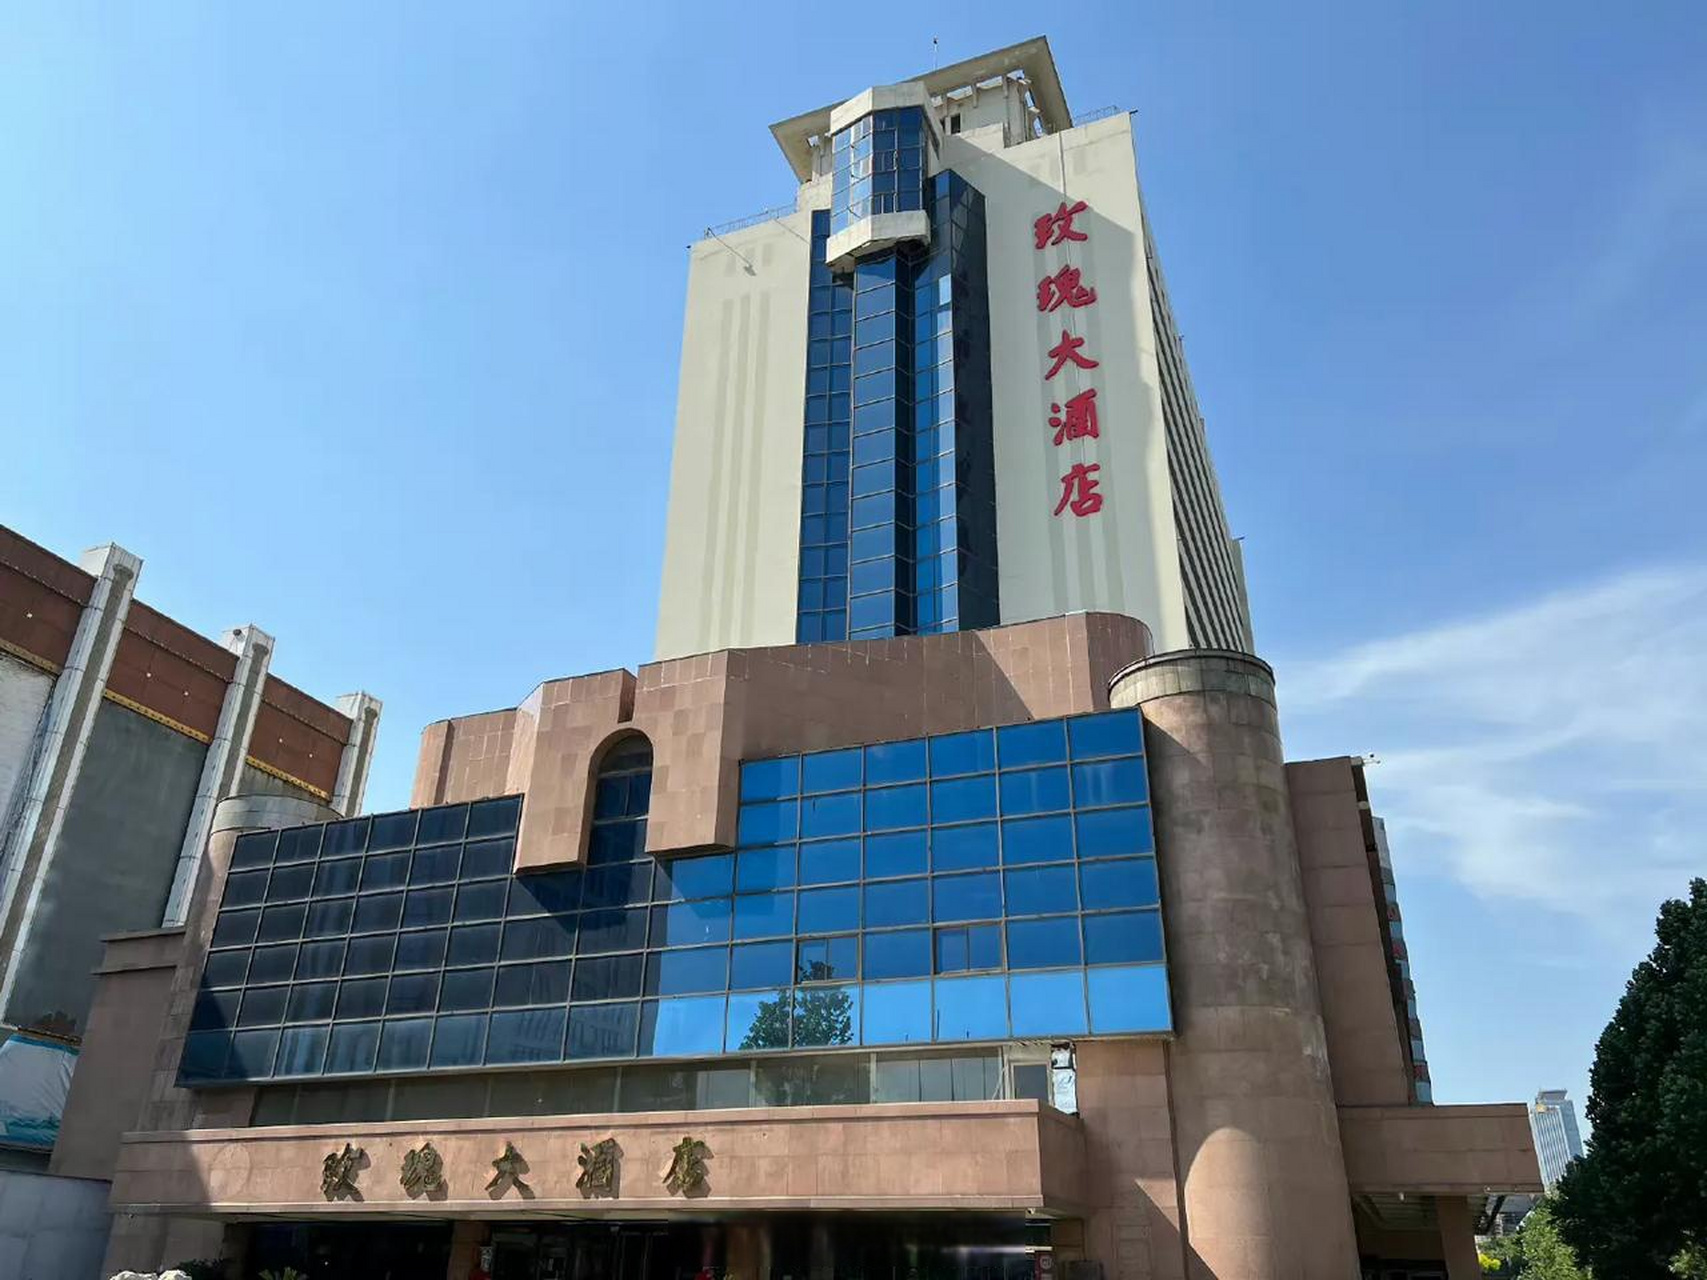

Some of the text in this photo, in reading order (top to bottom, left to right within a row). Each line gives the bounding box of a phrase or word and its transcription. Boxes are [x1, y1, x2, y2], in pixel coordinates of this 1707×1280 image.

[1034, 201, 1104, 517] 玫瑰大酒店
[321, 1136, 707, 1198] 玫瑰大酒店
